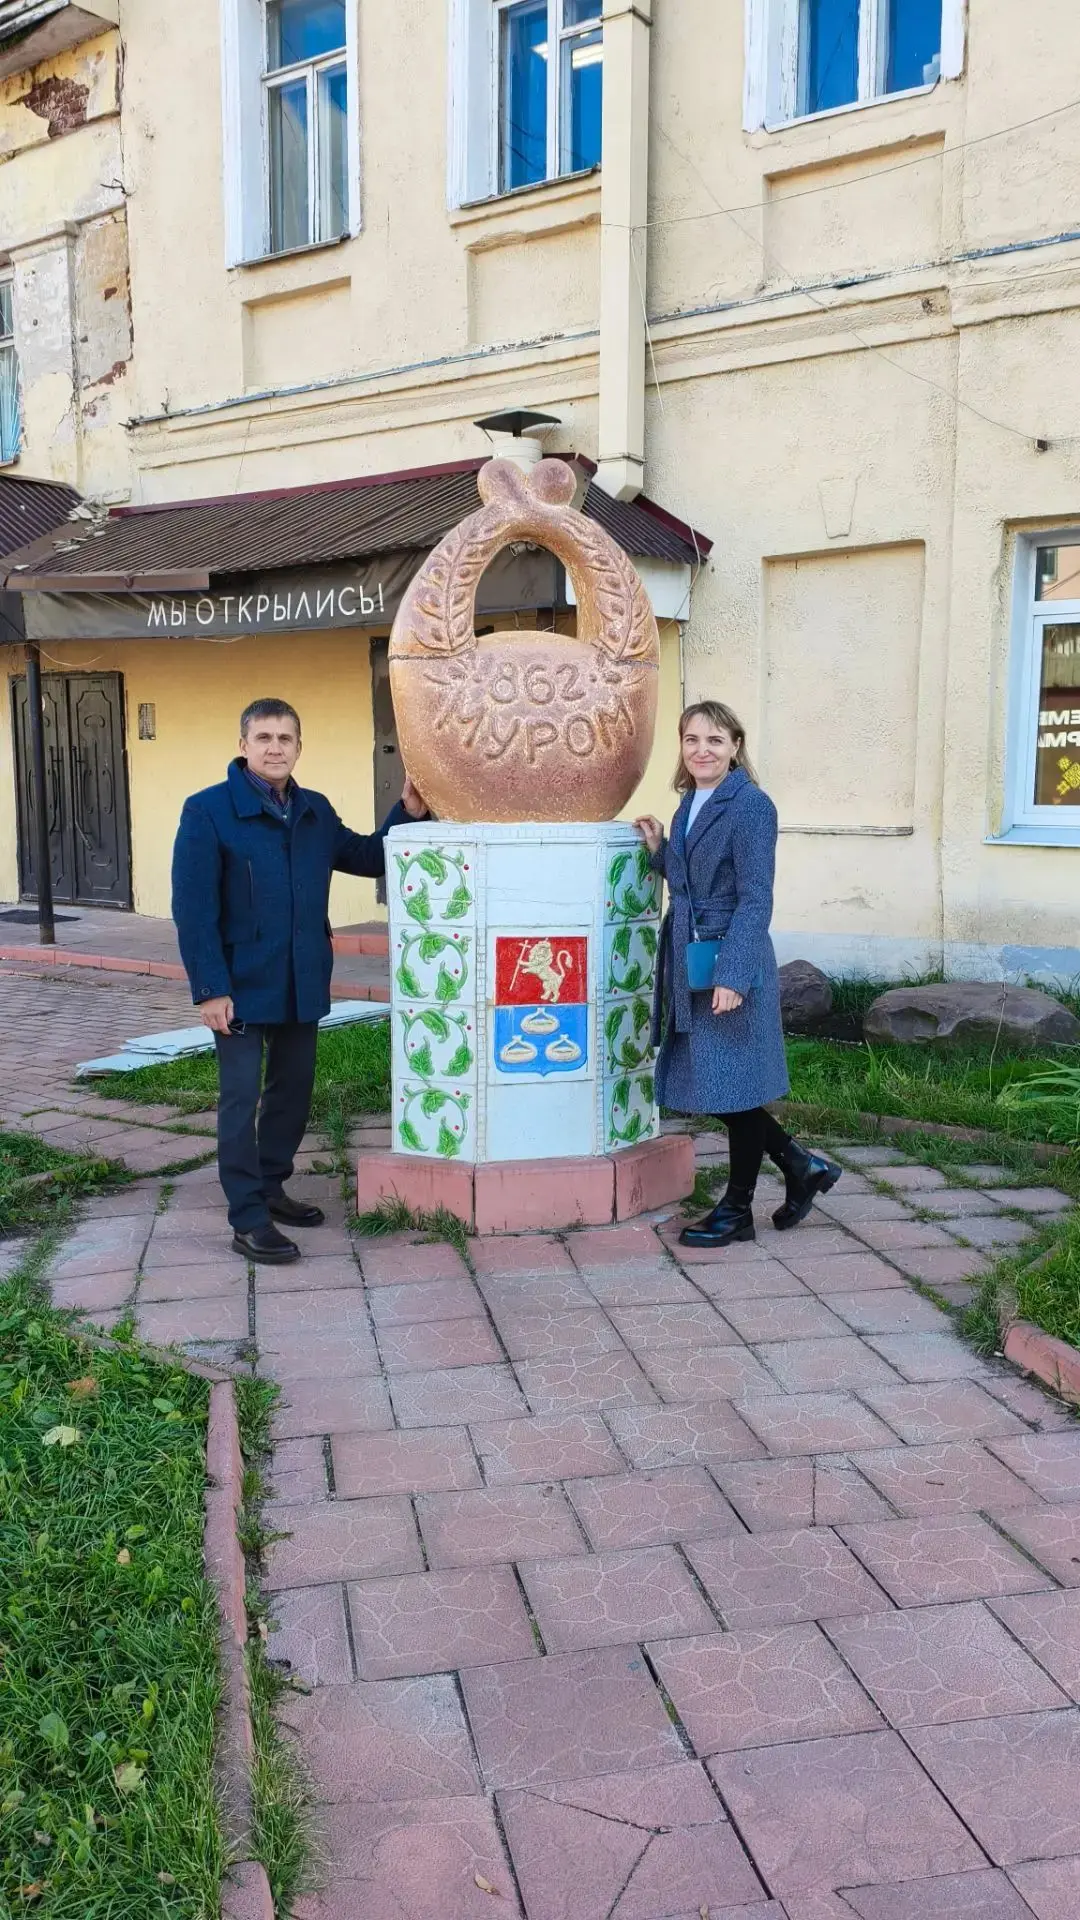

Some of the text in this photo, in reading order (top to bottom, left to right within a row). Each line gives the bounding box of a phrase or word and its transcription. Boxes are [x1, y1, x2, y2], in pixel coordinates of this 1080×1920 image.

[147, 583, 385, 627] МЫ ОТКРЫЛИСЬ!
[489, 662, 586, 705] 862
[435, 697, 636, 764] МУРОМ
